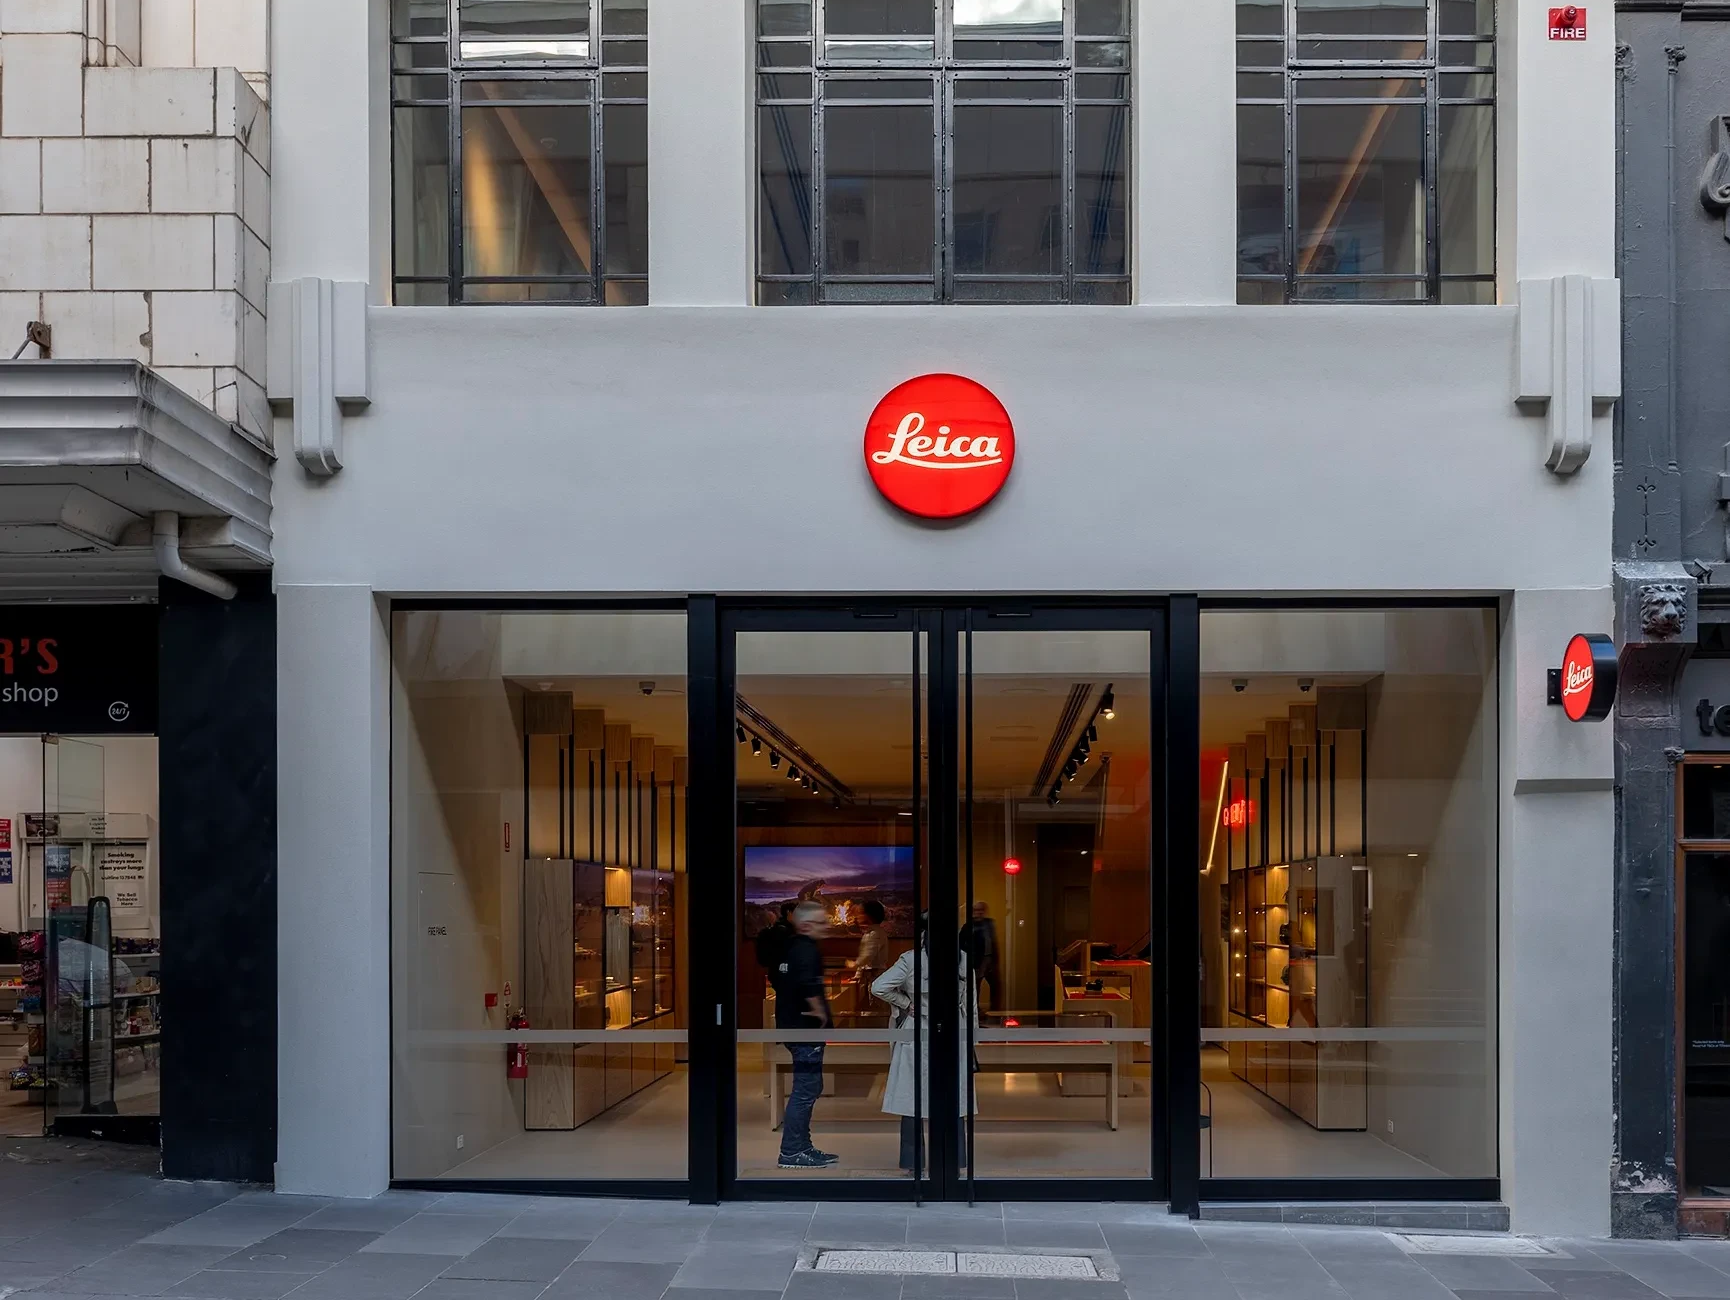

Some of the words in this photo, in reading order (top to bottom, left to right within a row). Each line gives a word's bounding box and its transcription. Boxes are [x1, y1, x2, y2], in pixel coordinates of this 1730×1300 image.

[1550, 27, 1585, 38] FIRE
[872, 412, 1002, 469] Leica
[1563, 661, 1593, 696] Leica
[2, 682, 59, 707] shop
[111, 707, 126, 715] 24/7
